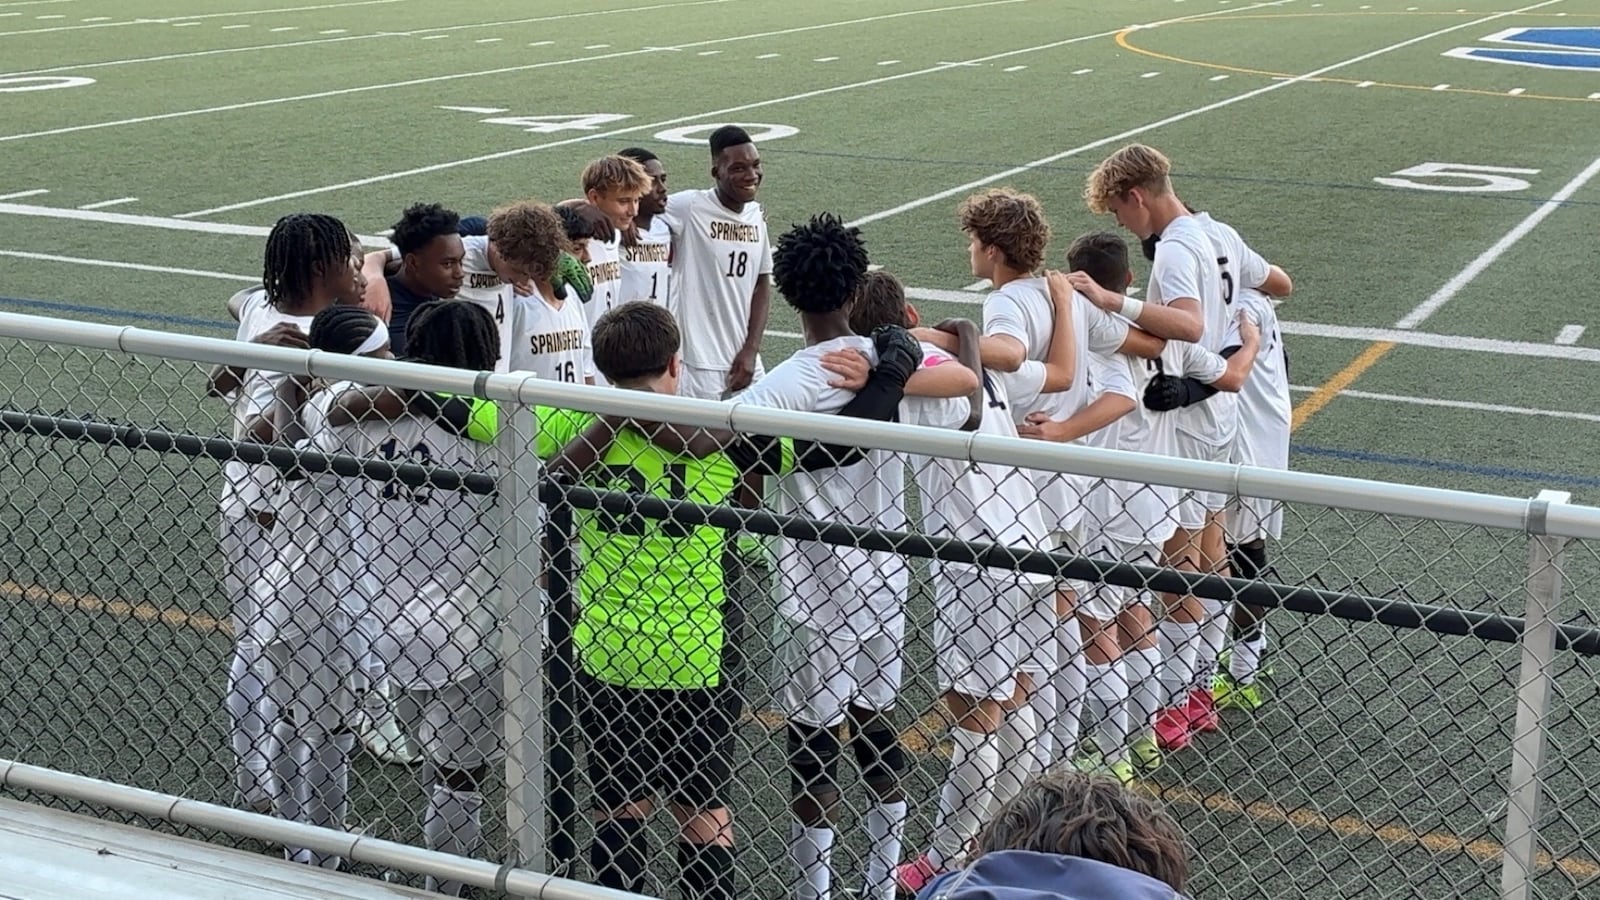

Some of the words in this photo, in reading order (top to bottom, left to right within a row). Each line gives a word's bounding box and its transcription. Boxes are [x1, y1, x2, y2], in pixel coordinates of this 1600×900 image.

[1373, 162, 1542, 192] 5
[726, 250, 748, 278] 18
[649, 271, 658, 299] 1
[1216, 256, 1234, 306] 5
[495, 293, 505, 324] 4
[554, 360, 575, 383] 16
